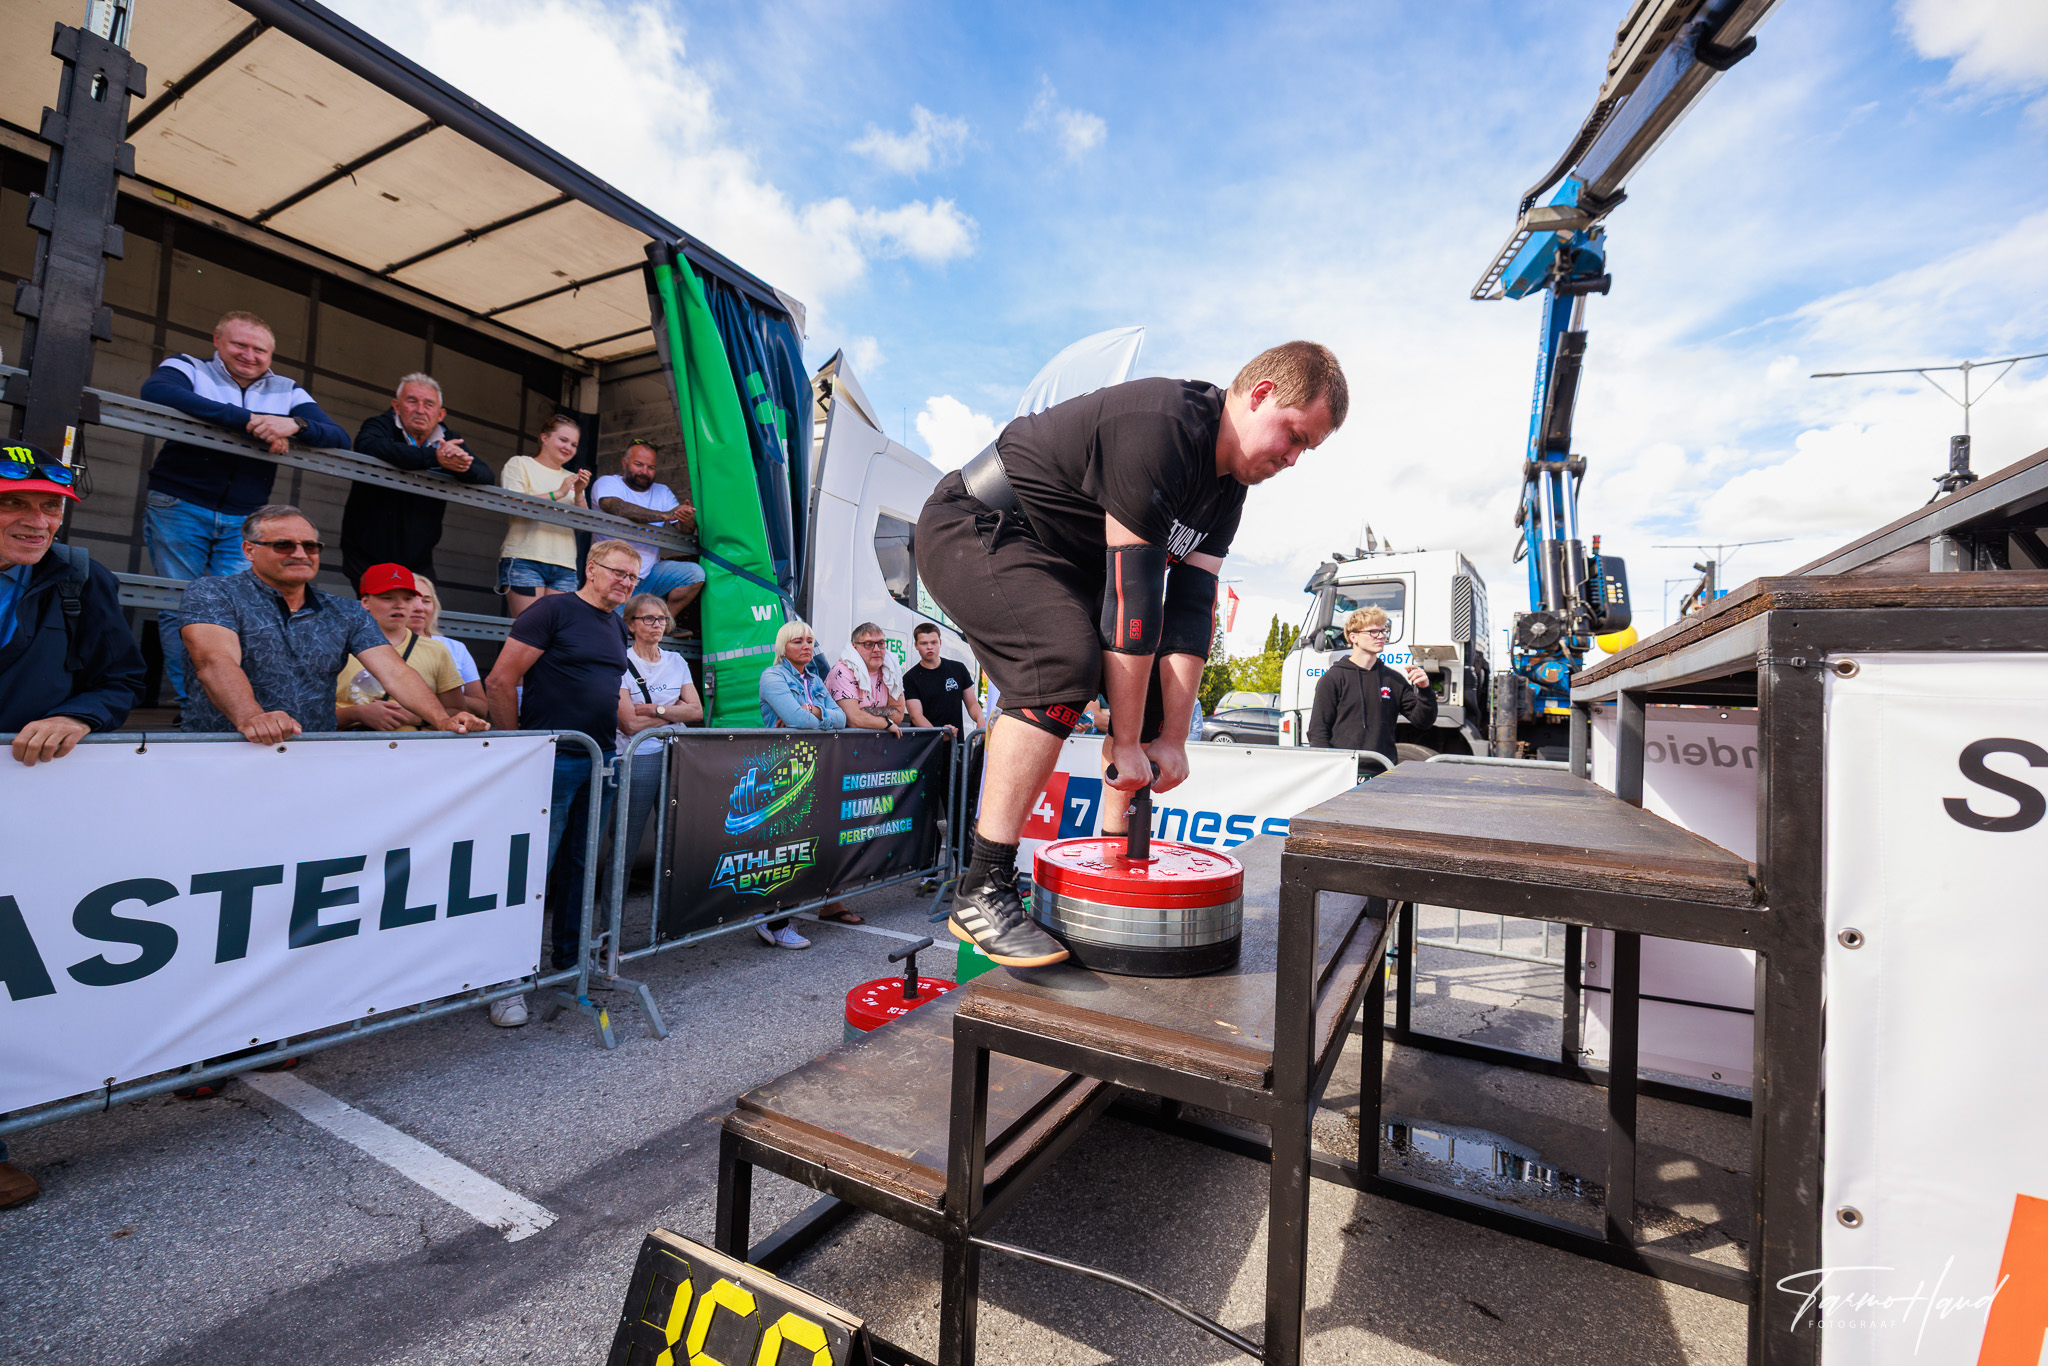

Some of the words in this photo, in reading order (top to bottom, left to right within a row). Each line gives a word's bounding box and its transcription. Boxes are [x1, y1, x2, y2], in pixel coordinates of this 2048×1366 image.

[1131, 620, 1140, 638] SBD
[1050, 705, 1078, 725] SBD
[842, 768, 918, 791] ENGINEERING
[841, 795, 894, 820] HUMAN
[1071, 798, 1091, 827] 7
[717, 841, 811, 880] ATHLETE
[740, 865, 791, 888] BYTES
